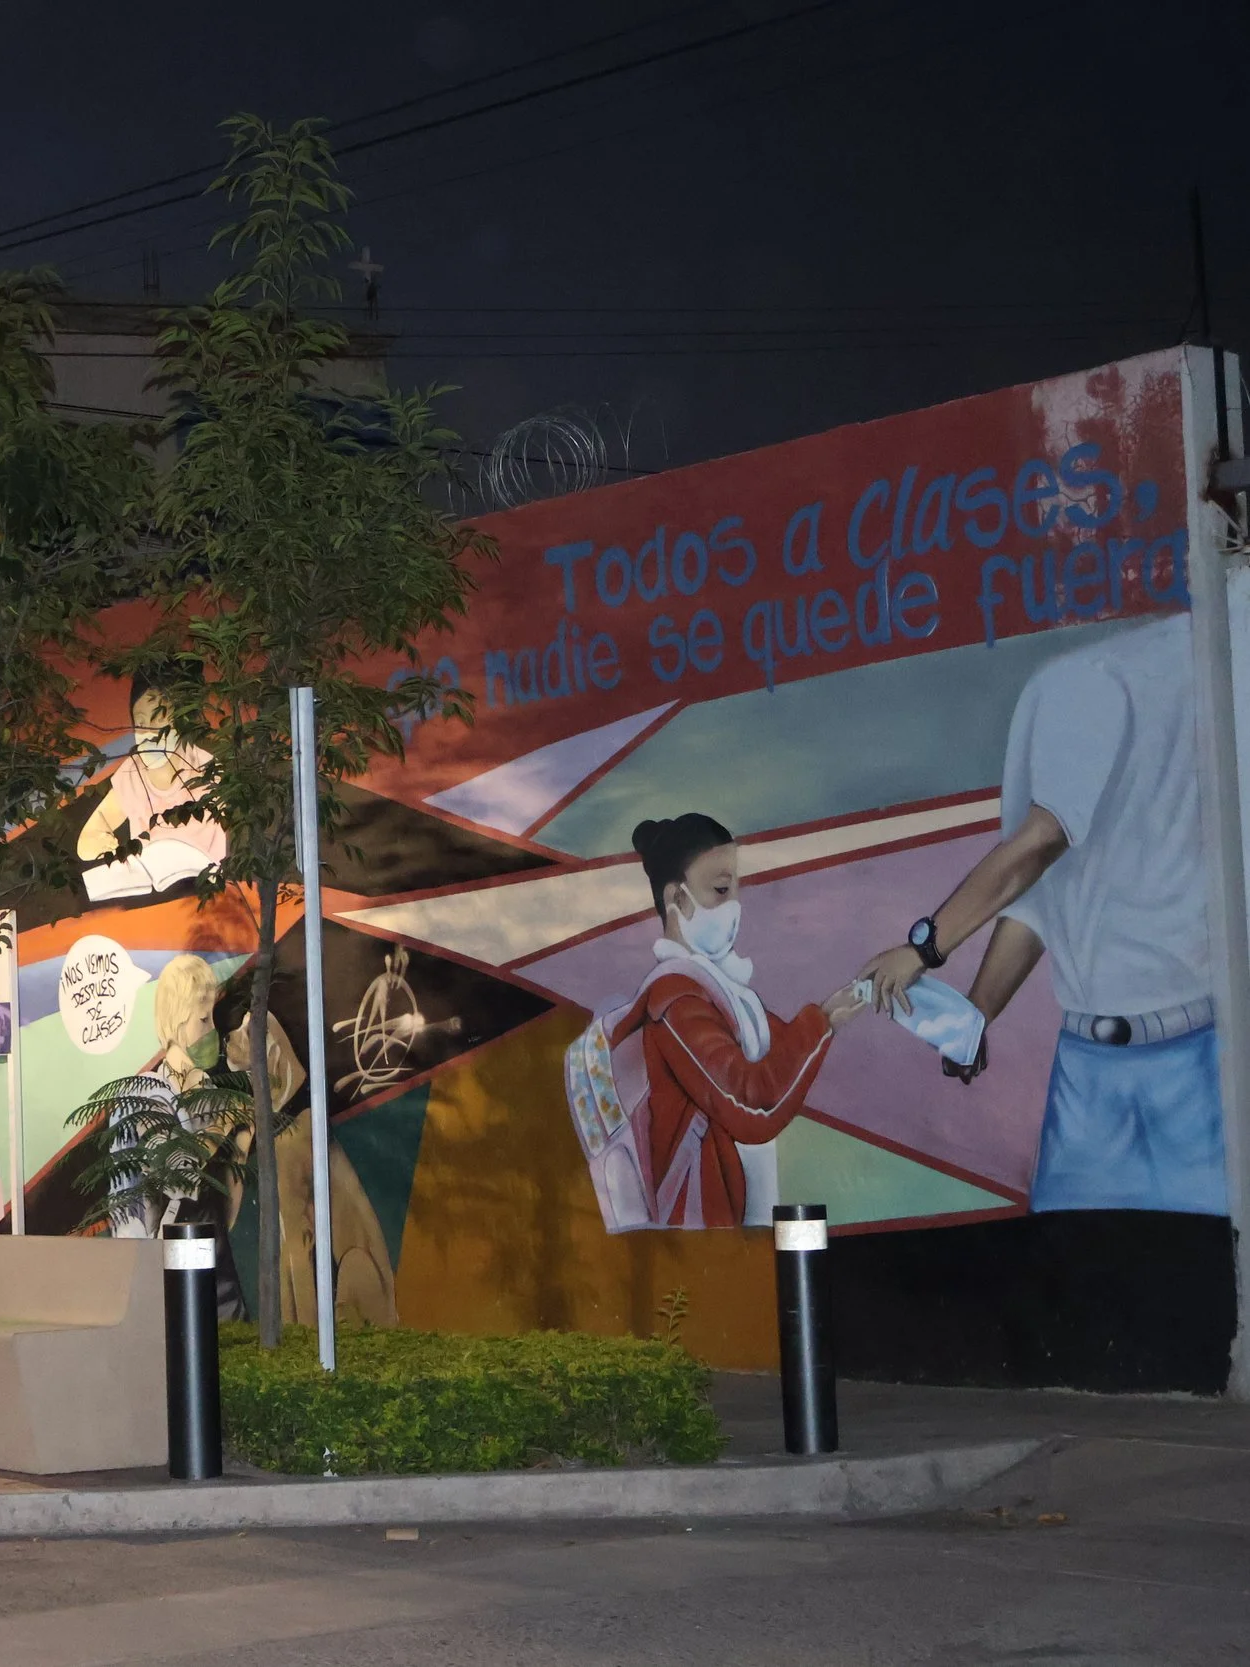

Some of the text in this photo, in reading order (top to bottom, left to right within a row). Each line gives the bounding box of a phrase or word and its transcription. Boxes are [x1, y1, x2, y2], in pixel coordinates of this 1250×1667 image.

[545, 515, 757, 613] Todos
[783, 501, 826, 577] a
[483, 619, 623, 710] nadie
[743, 559, 940, 693] quede
[976, 528, 1192, 648] fuera
[85, 952, 120, 975] VEMOS
[82, 1003, 127, 1044] CLASES!
[86, 1001, 108, 1021] DE
